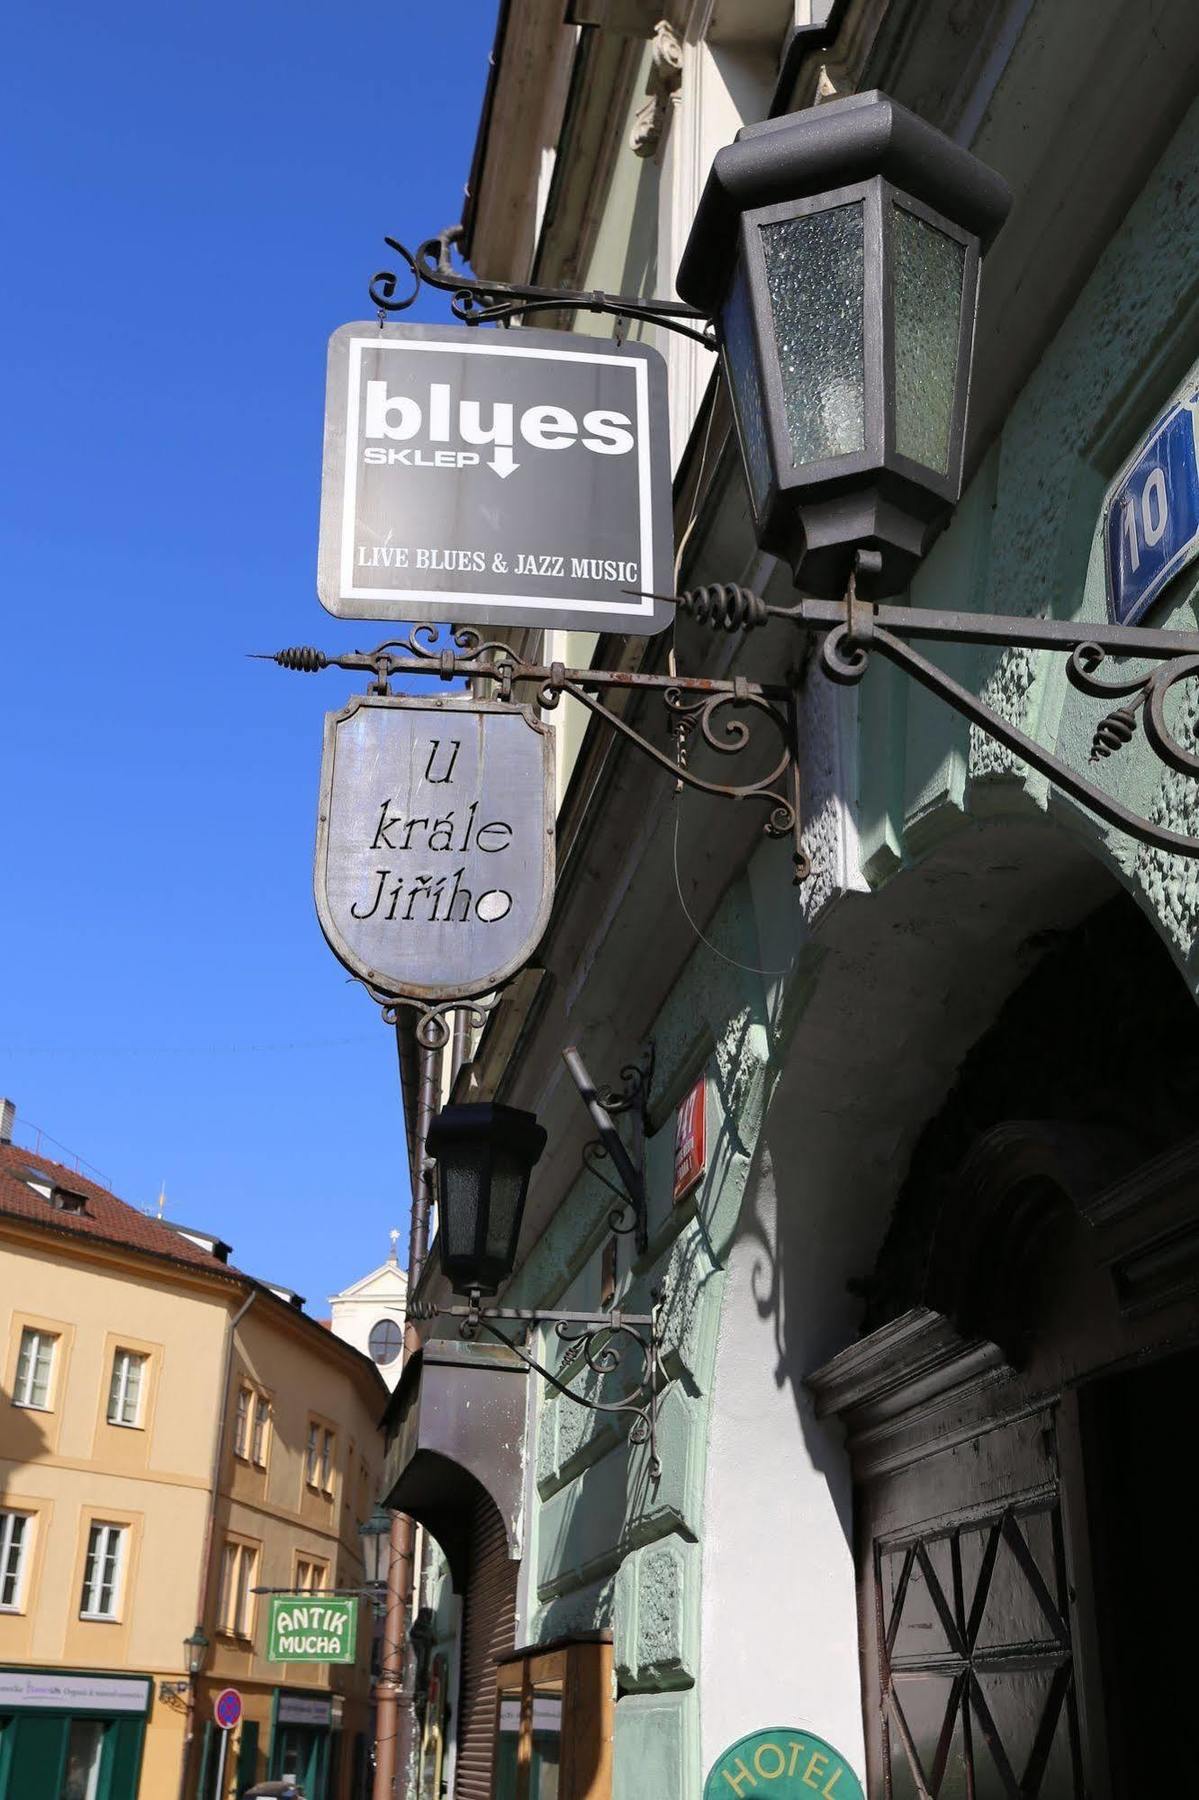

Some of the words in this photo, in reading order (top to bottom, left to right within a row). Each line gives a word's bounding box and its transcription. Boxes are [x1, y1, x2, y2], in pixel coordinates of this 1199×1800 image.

[364, 380, 635, 455] blues
[363, 447, 480, 468] SKLEP
[1123, 467, 1169, 574] 10
[358, 546, 409, 568] LIVE
[416, 548, 486, 573] BLUES
[492, 552, 509, 574] &
[514, 553, 565, 578] JAZZ
[570, 557, 638, 583] MUSIC
[369, 798, 513, 853] krále
[350, 866, 513, 924] Jiřího
[277, 1606, 349, 1636] ANTIK
[279, 1635, 341, 1655] MUCHA
[721, 1741, 843, 1800] HOTEL
